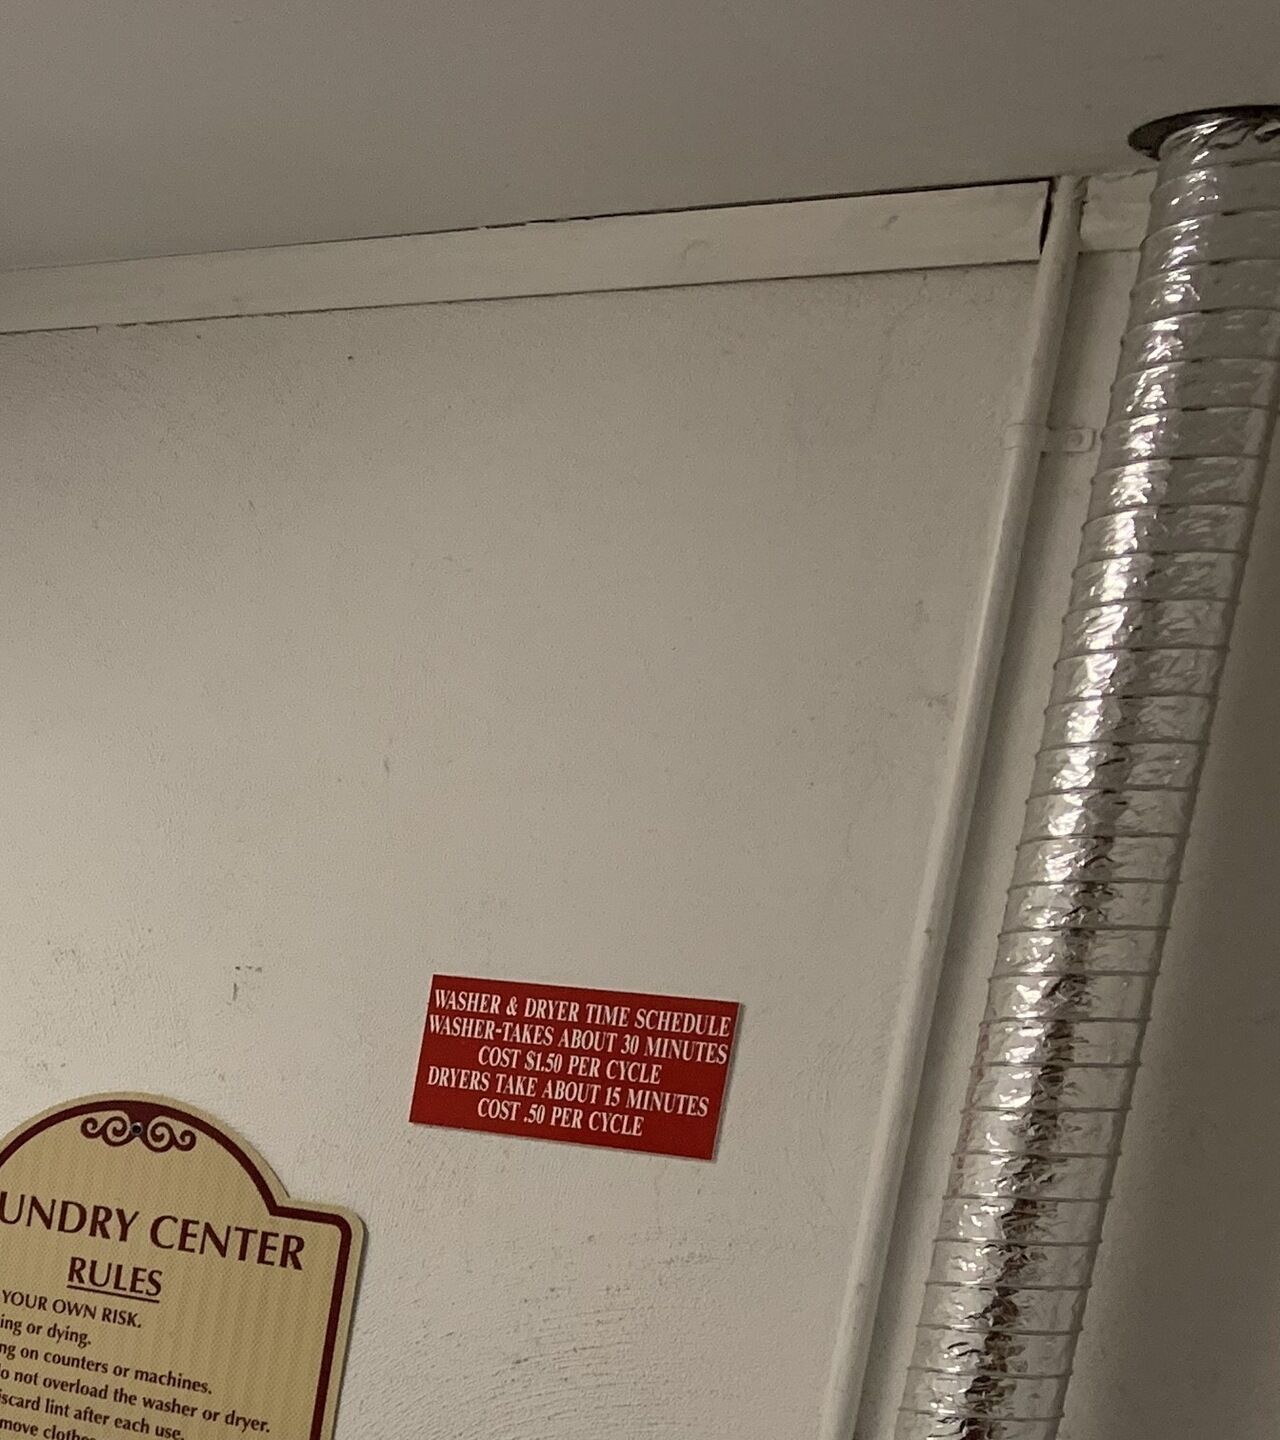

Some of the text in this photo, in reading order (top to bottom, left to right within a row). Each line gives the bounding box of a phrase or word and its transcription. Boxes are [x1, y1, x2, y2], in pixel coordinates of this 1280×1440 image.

[435, 988, 731, 1037] WASHER & DRYER TIME SCHEDULE
[429, 1013, 730, 1065] WASHER-TAKES ABOUT 30 MINUTES
[478, 1045, 662, 1084] COST $1.50 PER CYCLE
[427, 1065, 709, 1117] DRYERS TAKE ABOUT 15 MINUTES
[477, 1098, 644, 1136] COST .50 PER CYCLE
[149, 1215, 305, 1271] CENTER
[67, 1256, 163, 1296] RULES
[2, 1289, 48, 1311] YOUR
[51, 1298, 97, 1320] OWN
[101, 1306, 142, 1328] RISK.
[25, 1322, 43, 1335] or
[46, 1322, 91, 1349] dying.
[19, 1347, 39, 1361] on
[43, 1351, 109, 1374] counters
[112, 1364, 130, 1378] or
[133, 1369, 212, 1395] machines.
[13, 1371, 39, 1386] not
[42, 1377, 109, 1400] overload
[113, 1386, 137, 1406] the
[142, 1396, 198, 1417] washer
[201, 1409, 221, 1422] or
[224, 1409, 270, 1433] dryer.
[44, 1397, 70, 1418] lint
[73, 1405, 110, 1425] after
[113, 1417, 150, 1434] each
